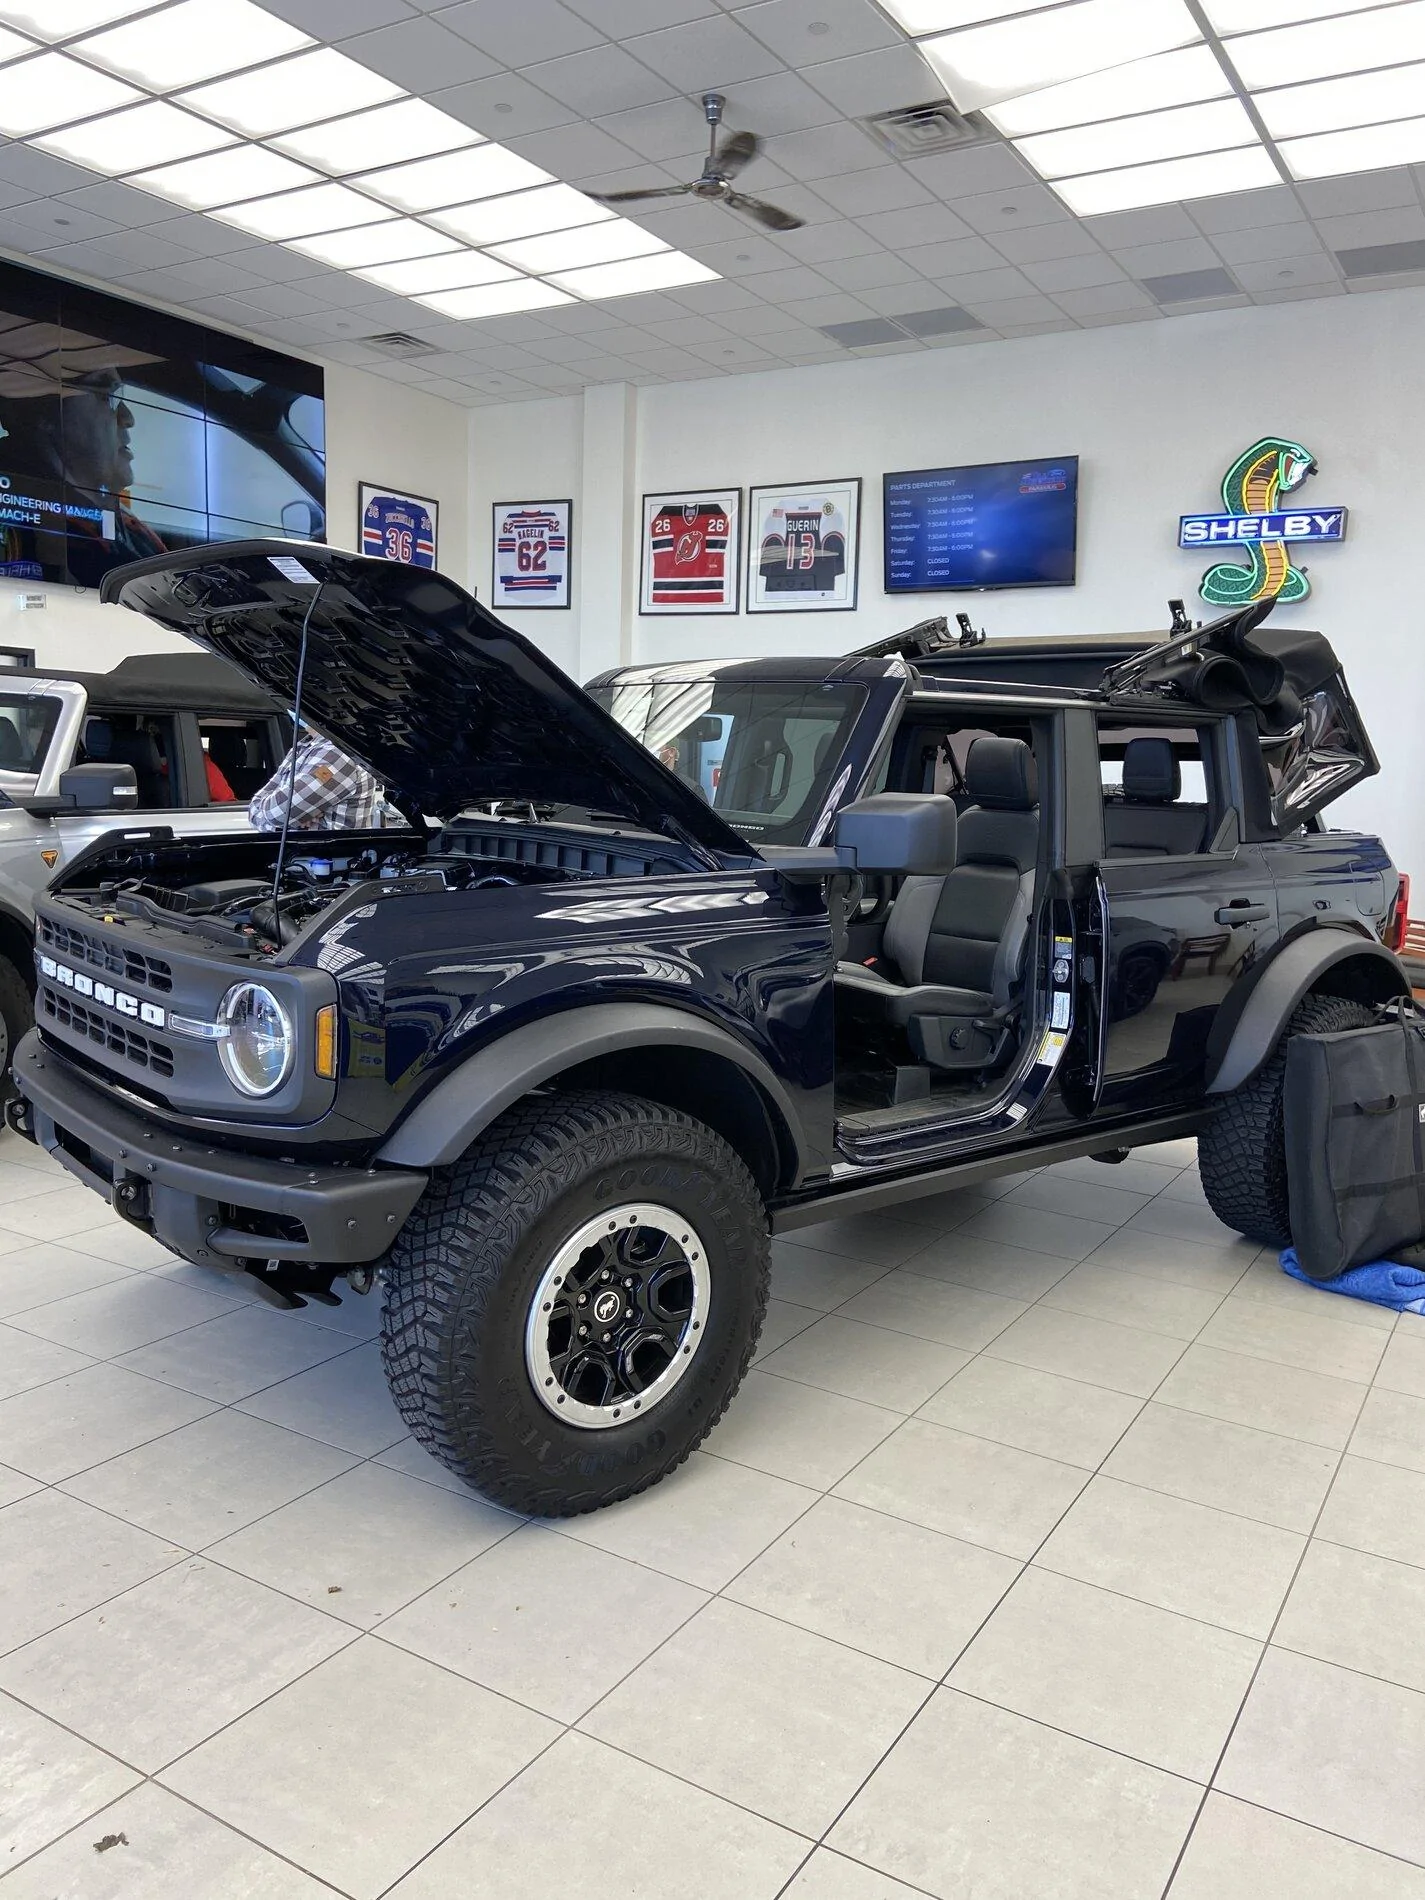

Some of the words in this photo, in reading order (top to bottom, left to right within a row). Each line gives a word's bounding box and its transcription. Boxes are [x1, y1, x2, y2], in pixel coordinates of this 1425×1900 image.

[889, 483, 911, 491] PARTS
[912, 480, 956, 490] DEPARTMENT
[502, 522, 514, 534] 62
[548, 520, 560, 532] 62
[655, 518, 671, 533] 26
[707, 518, 724, 532] 26
[787, 519, 819, 531] GUERIN
[1184, 513, 1342, 542] SHELBY
[385, 527, 413, 563] 36
[786, 533, 816, 570] 13
[517, 540, 548, 572] 62
[927, 557, 950, 565] CLOSED
[927, 569, 950, 577] CLOSED
[40, 955, 165, 1027] BRONCO
